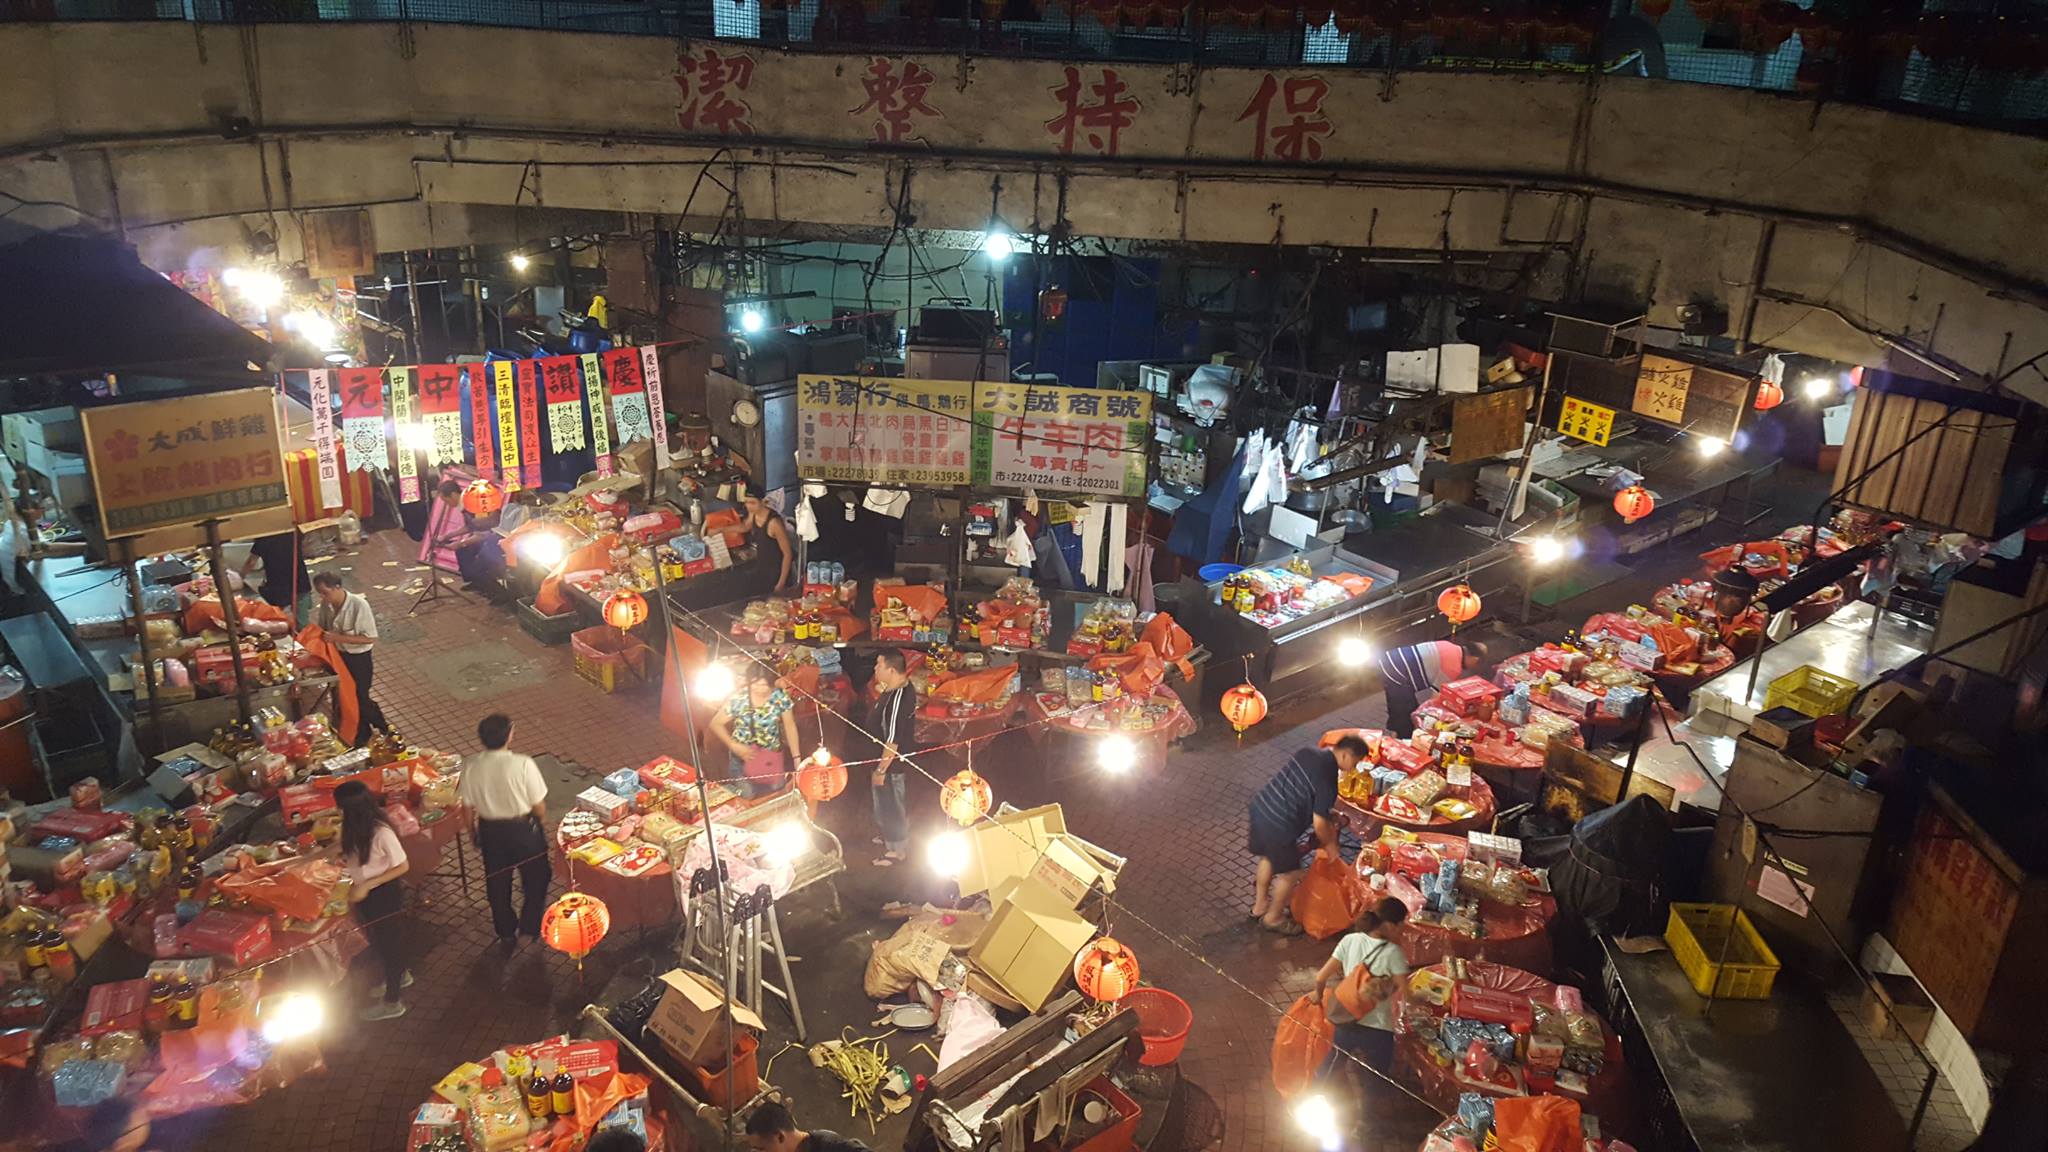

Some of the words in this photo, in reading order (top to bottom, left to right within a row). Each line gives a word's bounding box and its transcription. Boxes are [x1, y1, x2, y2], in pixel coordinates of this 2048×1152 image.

[612, 355, 637, 388] 慶
[344, 375, 378, 408] 元
[423, 372, 453, 406] 中
[982, 386, 1142, 419] 大誠商號
[999, 416, 1122, 459] 牛羊肉
